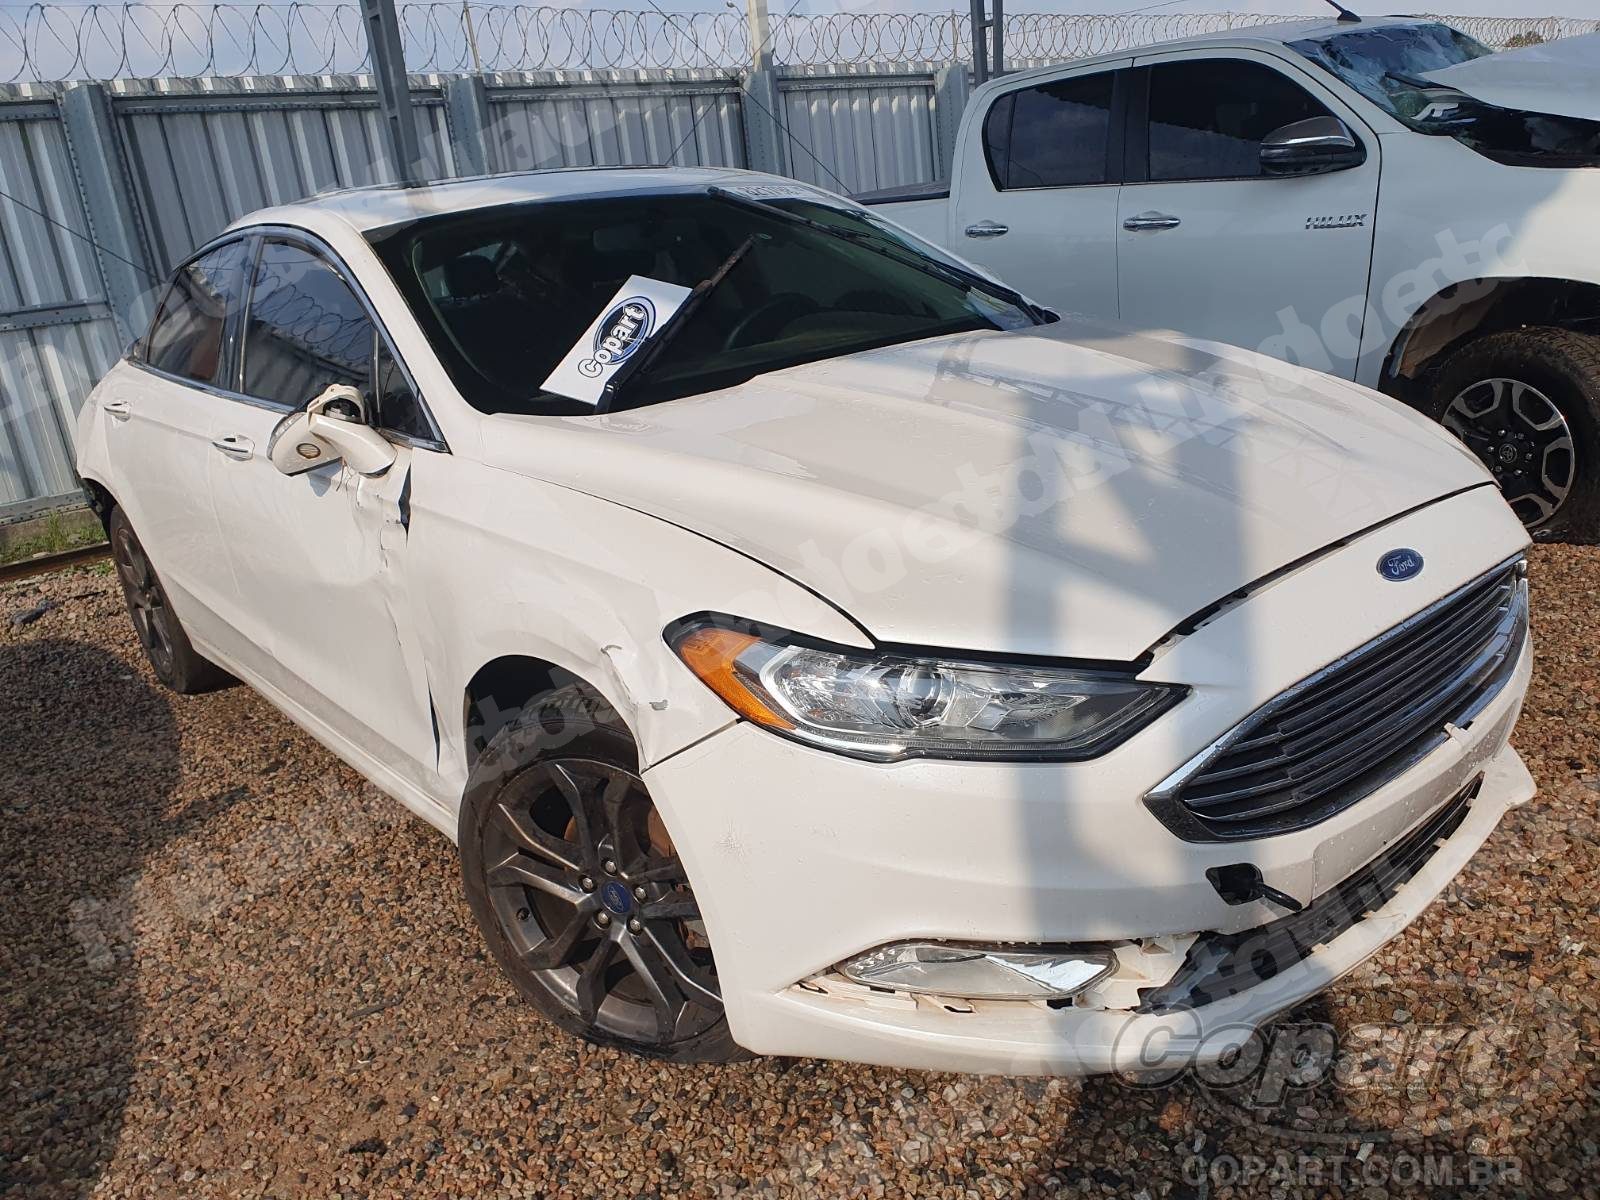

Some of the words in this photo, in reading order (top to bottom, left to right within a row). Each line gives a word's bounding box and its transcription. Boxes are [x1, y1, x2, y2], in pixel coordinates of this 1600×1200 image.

[1305, 213, 1368, 230] HILUX
[577, 304, 646, 378] Copart
[1387, 555, 1415, 576] Ford
